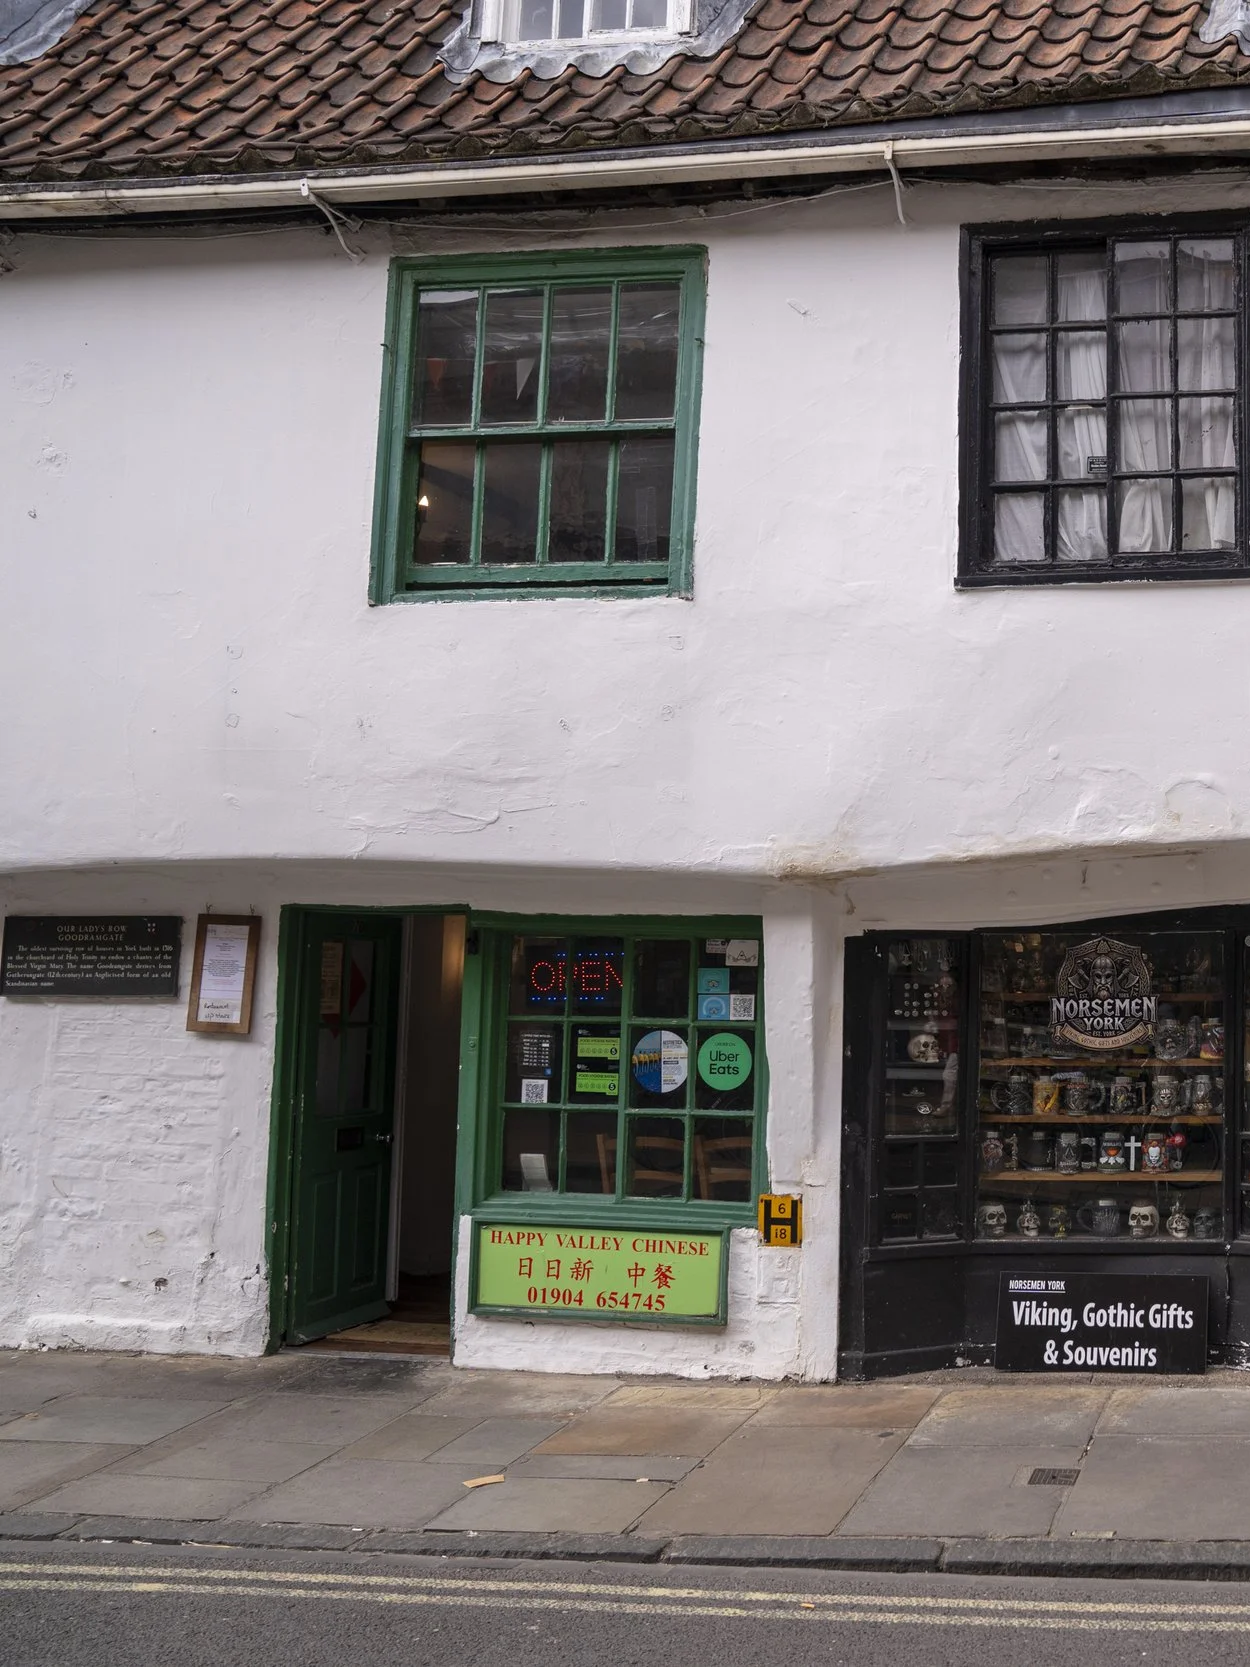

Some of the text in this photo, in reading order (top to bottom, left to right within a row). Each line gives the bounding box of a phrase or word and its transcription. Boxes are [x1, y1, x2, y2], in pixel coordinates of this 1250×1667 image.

[531, 961, 624, 991] OPEN
[1052, 997, 1156, 1024] NORSEMEN
[1084, 1017, 1126, 1031] YORK
[709, 1050, 739, 1062] Uber
[709, 1064, 739, 1075] Eats
[778, 1203, 786, 1214] 6
[764, 1200, 798, 1243] H
[491, 1231, 709, 1256] HAPPY VALLEY CHINESE
[518, 1257, 676, 1289] 日日新 中餐
[1009, 1280, 1066, 1291] NORSEMEN YORK
[527, 1286, 665, 1311] 01904 654745
[1013, 1301, 1194, 1332] Viking, Gothic Gifts
[1044, 1340, 1157, 1367] & Souvenirs
